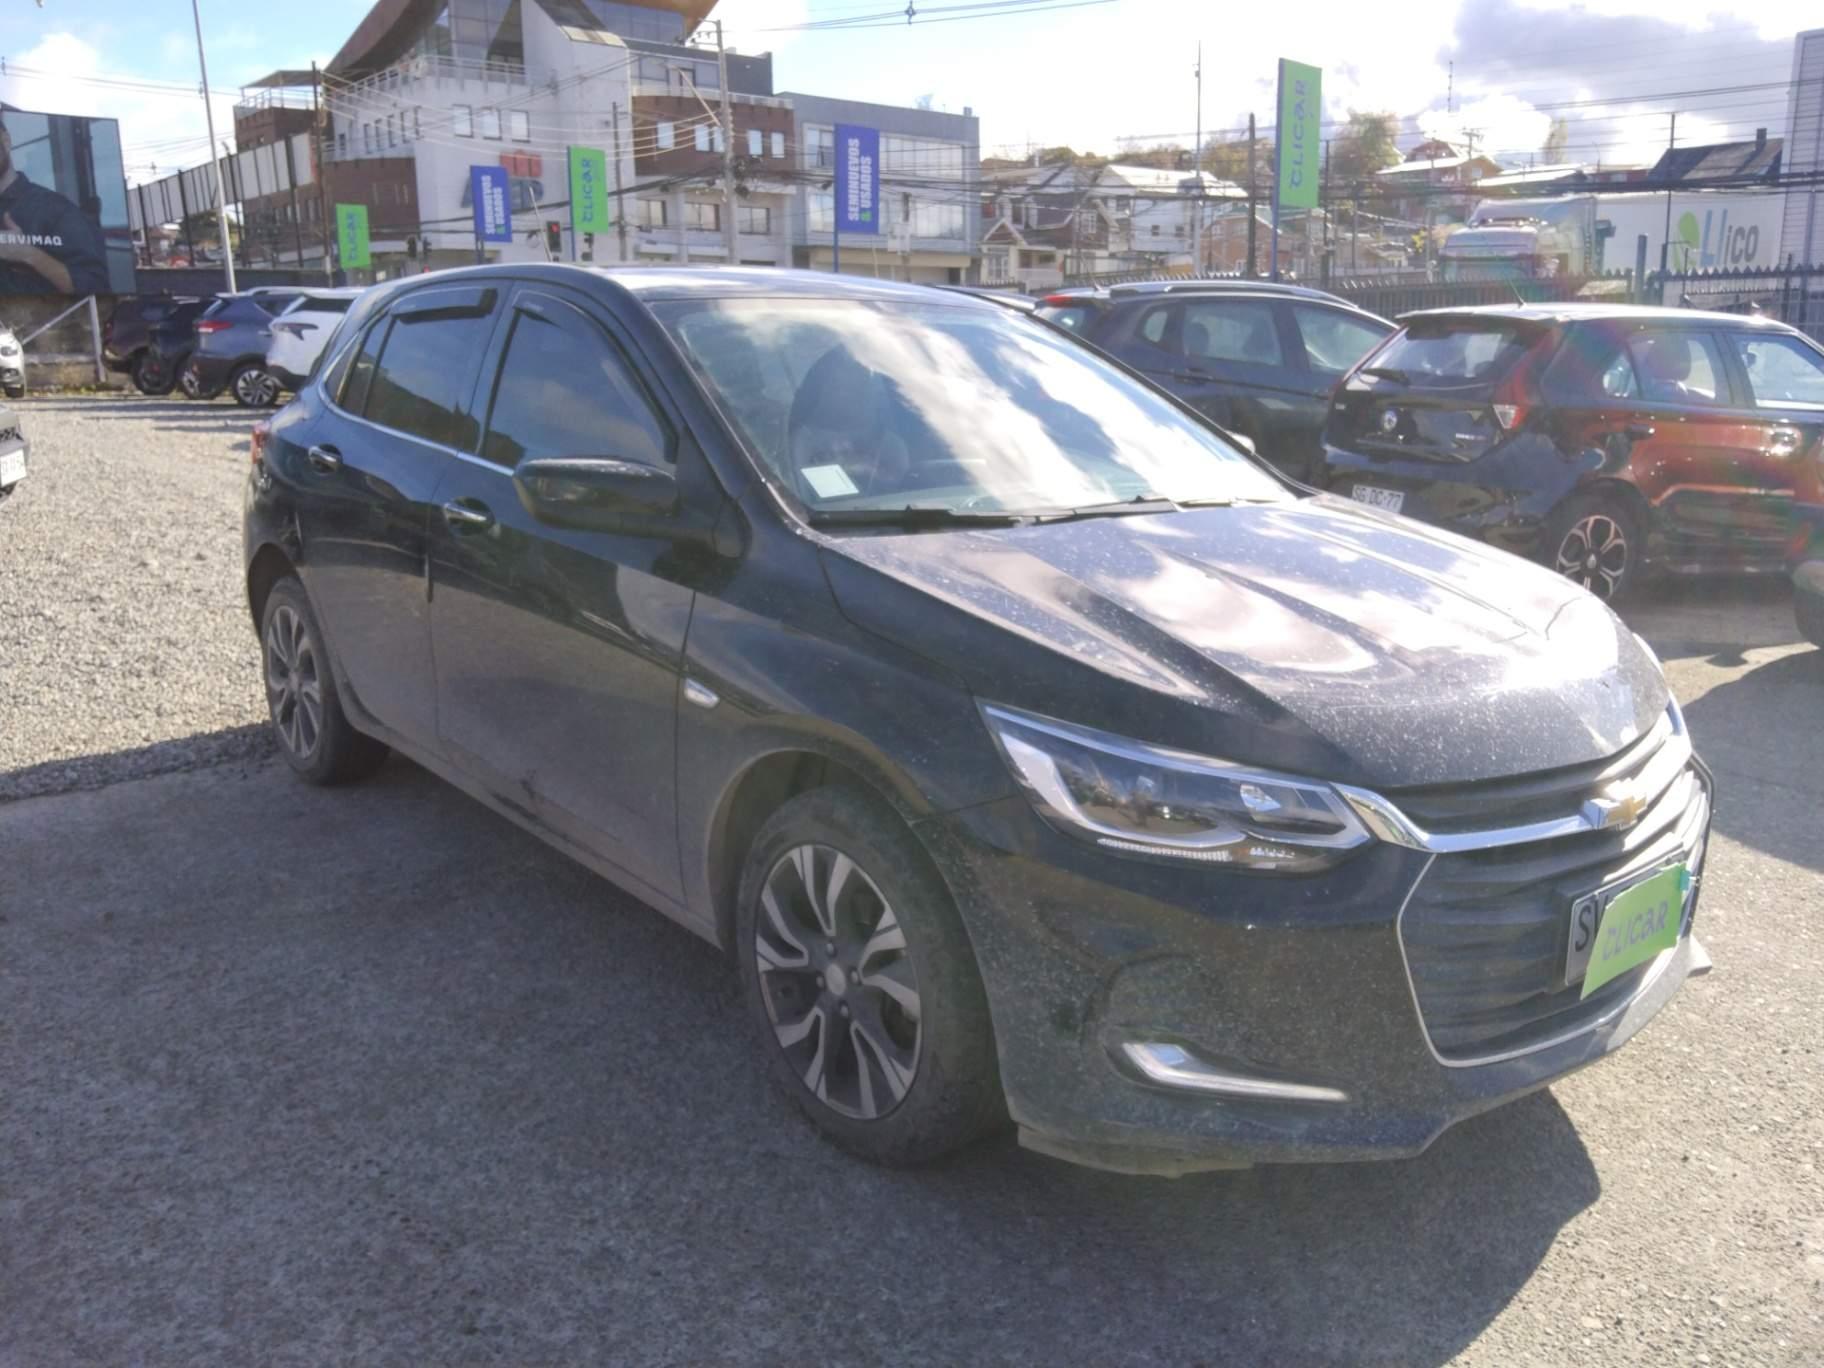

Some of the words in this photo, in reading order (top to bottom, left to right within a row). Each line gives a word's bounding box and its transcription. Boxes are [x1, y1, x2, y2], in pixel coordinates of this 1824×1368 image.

[481, 175, 496, 235] SEMINUEVOS
[493, 187, 505, 225] USADOS
[847, 138, 860, 221] SEMINUEVOS
[860, 155, 872, 209] USADOS
